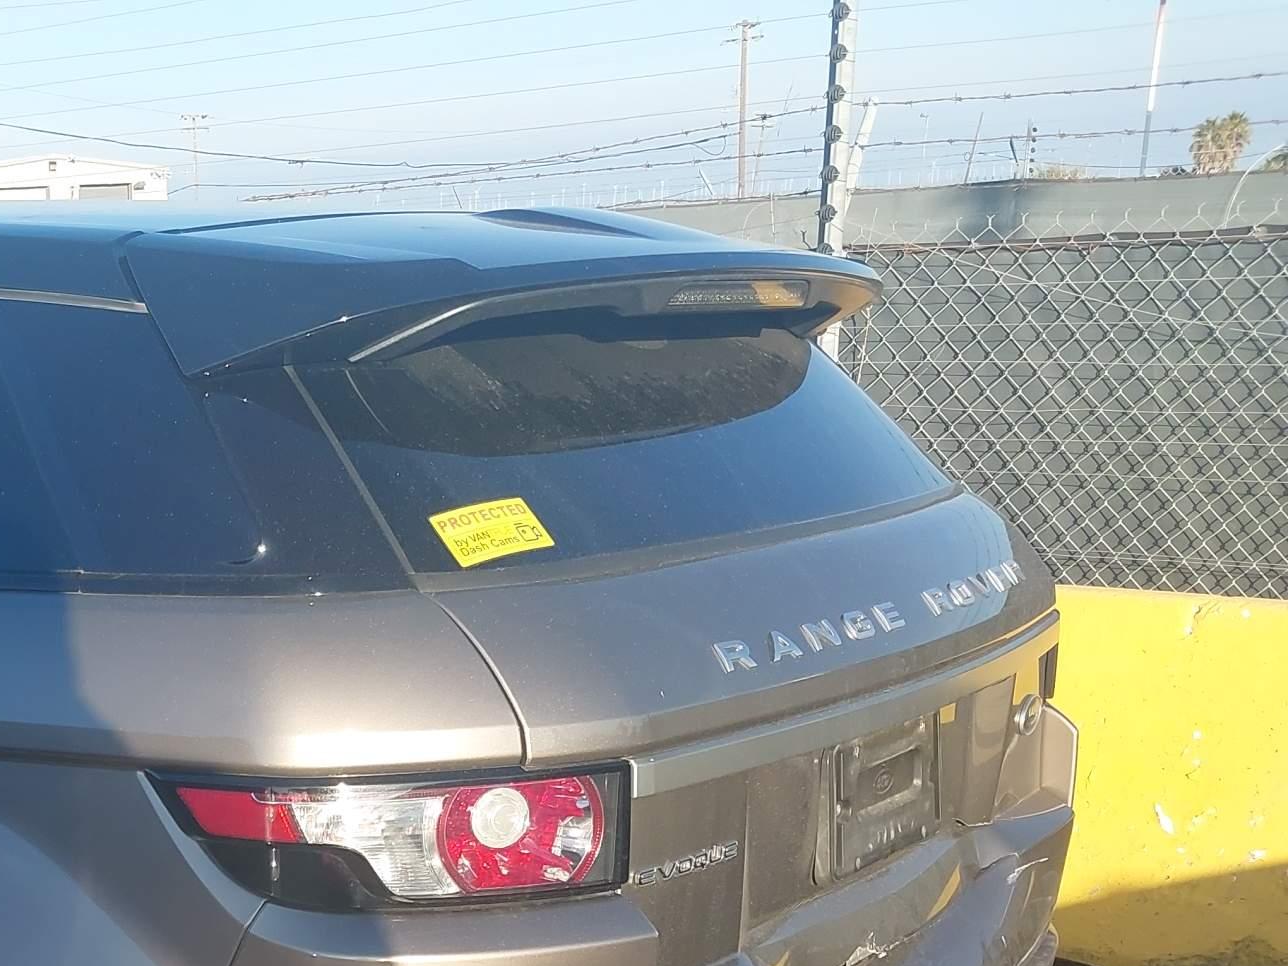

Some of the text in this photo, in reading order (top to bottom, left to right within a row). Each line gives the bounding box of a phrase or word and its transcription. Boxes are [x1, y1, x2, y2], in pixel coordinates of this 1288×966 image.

[436, 503, 528, 533] PROTECTED
[453, 538, 469, 548] by
[459, 536, 521, 557] Dash Cams
[712, 559, 1026, 674] RANGE ROVER
[634, 840, 740, 888] EVOQUE
